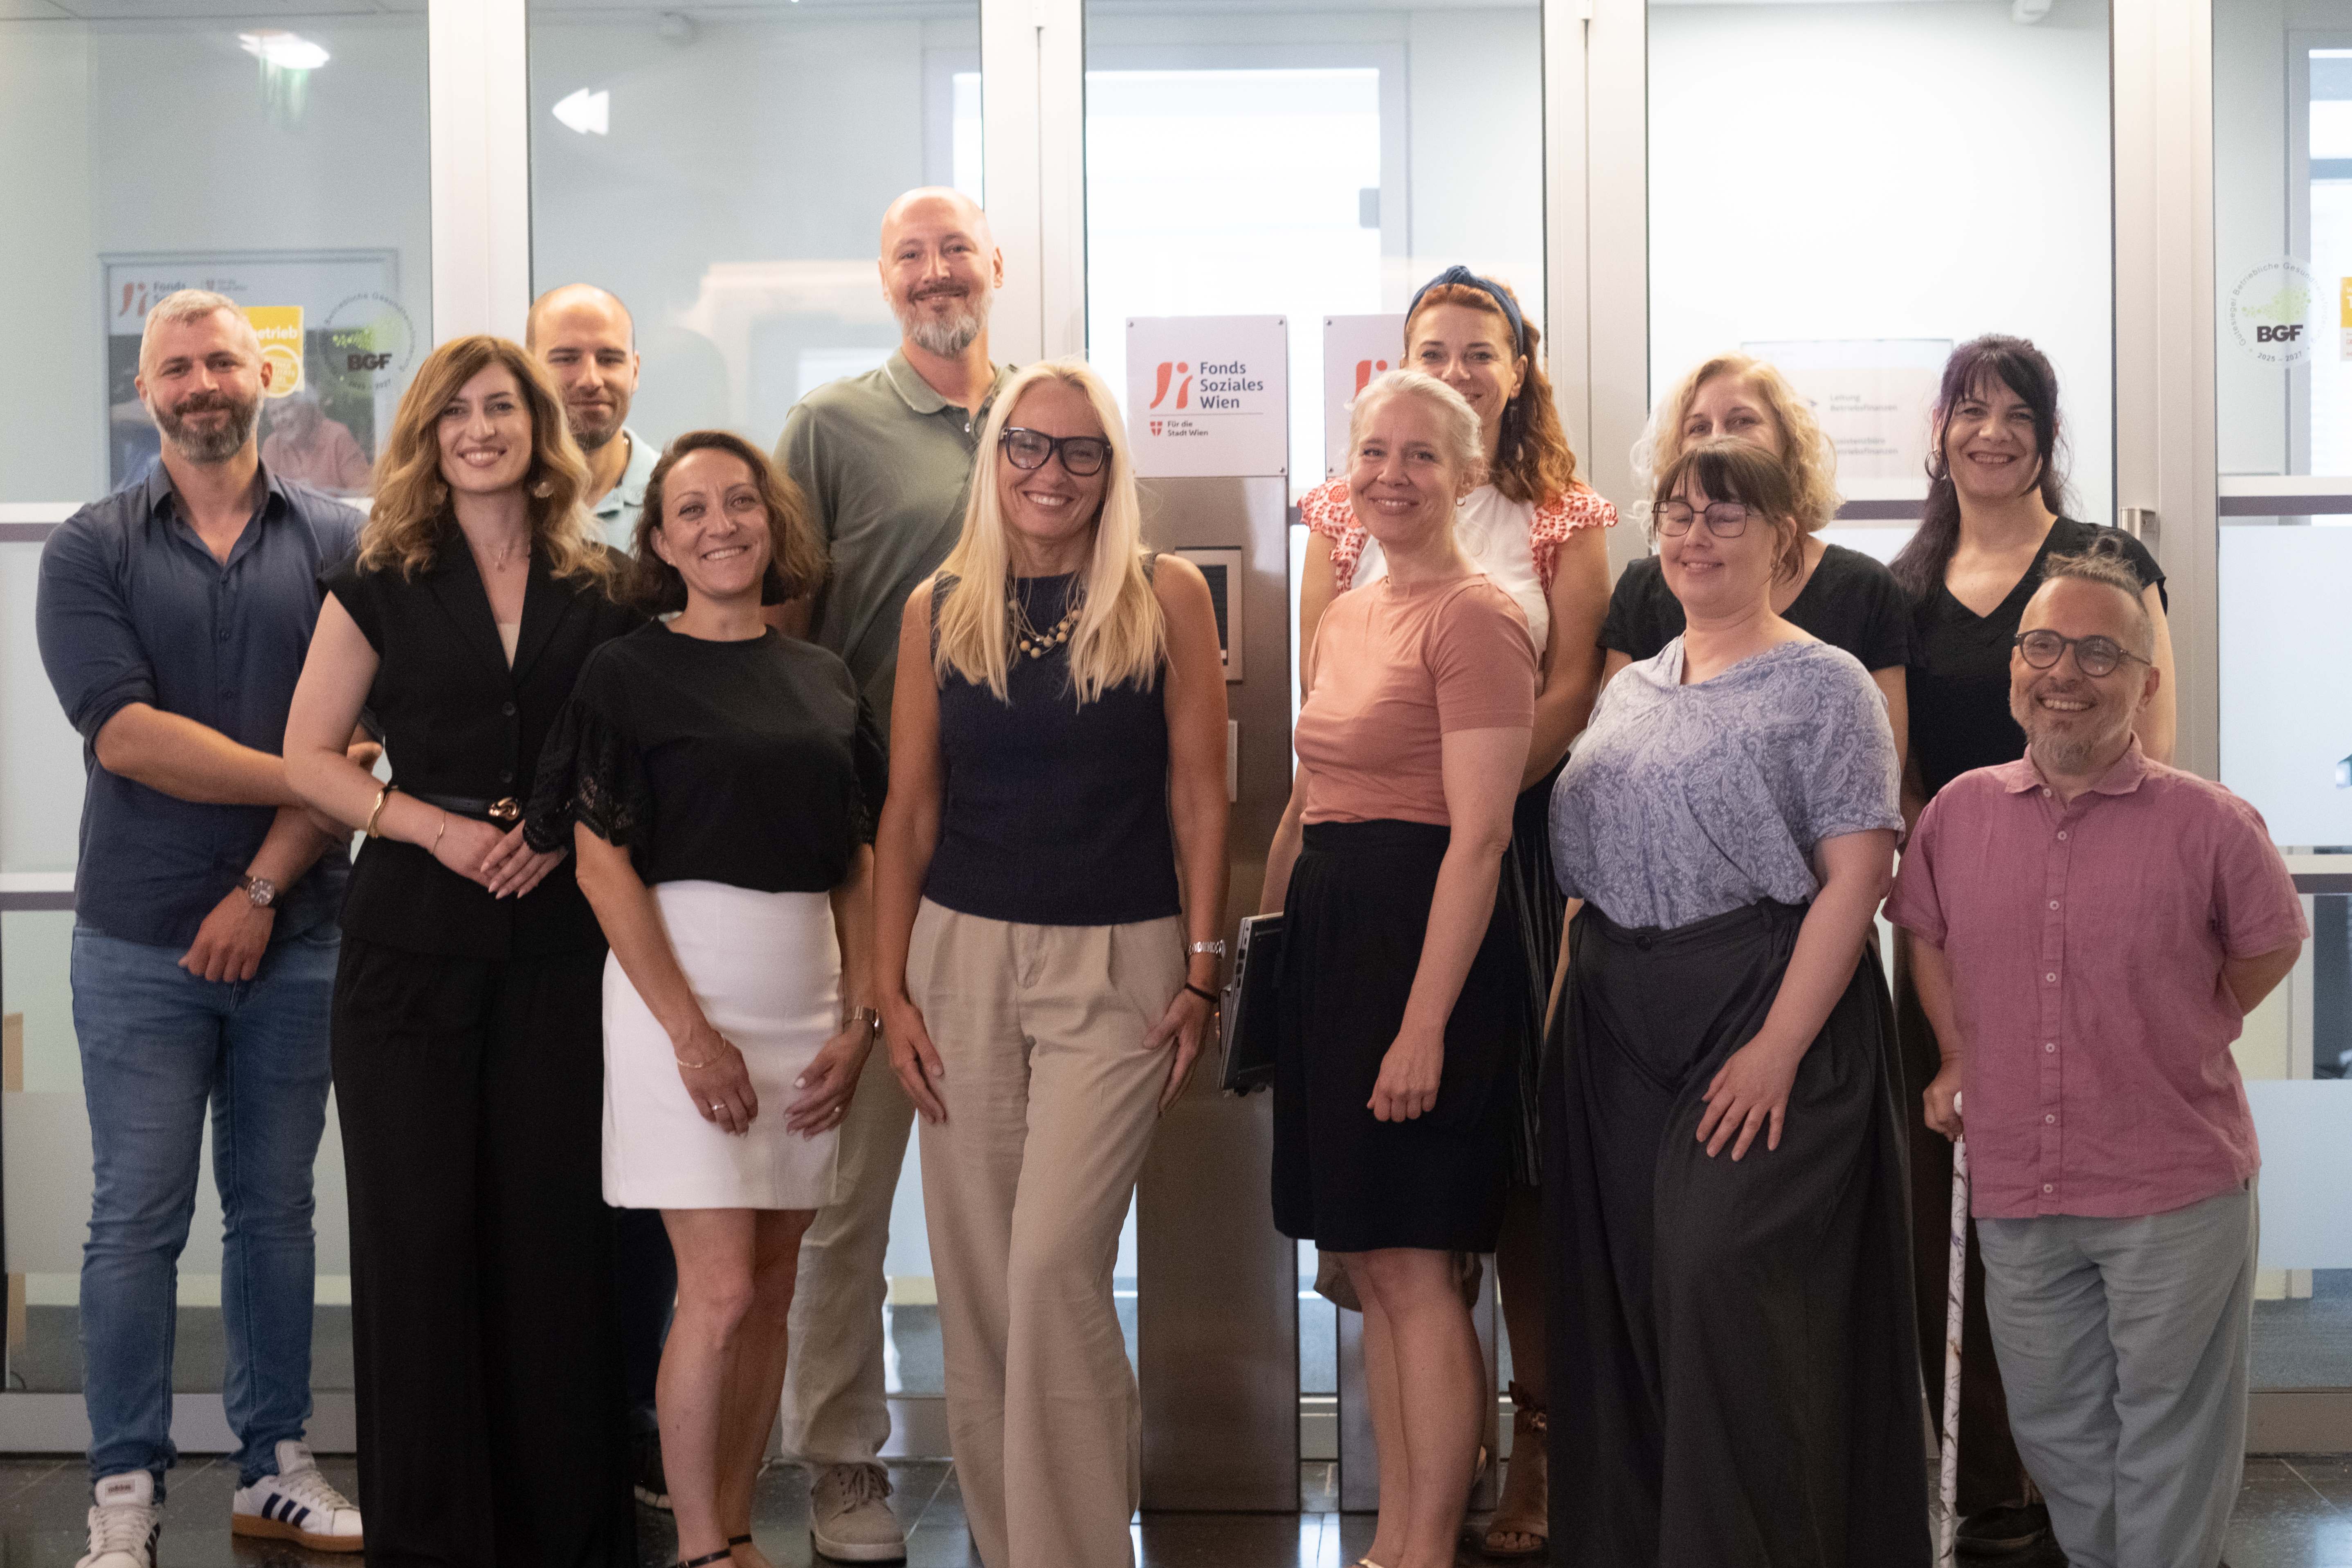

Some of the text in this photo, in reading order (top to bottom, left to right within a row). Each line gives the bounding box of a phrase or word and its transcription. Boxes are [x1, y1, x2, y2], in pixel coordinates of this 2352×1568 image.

[2233, 262, 2279, 296] Betriebliche
[2257, 325, 2303, 342] BGF
[348, 353, 392, 371] BGF
[2258, 353, 2275, 362] 2025
[2286, 351, 2302, 362] 2027
[1201, 361, 1246, 374] Fonds
[1201, 378, 1263, 392] Soziales
[1200, 395, 1239, 408] Wien
